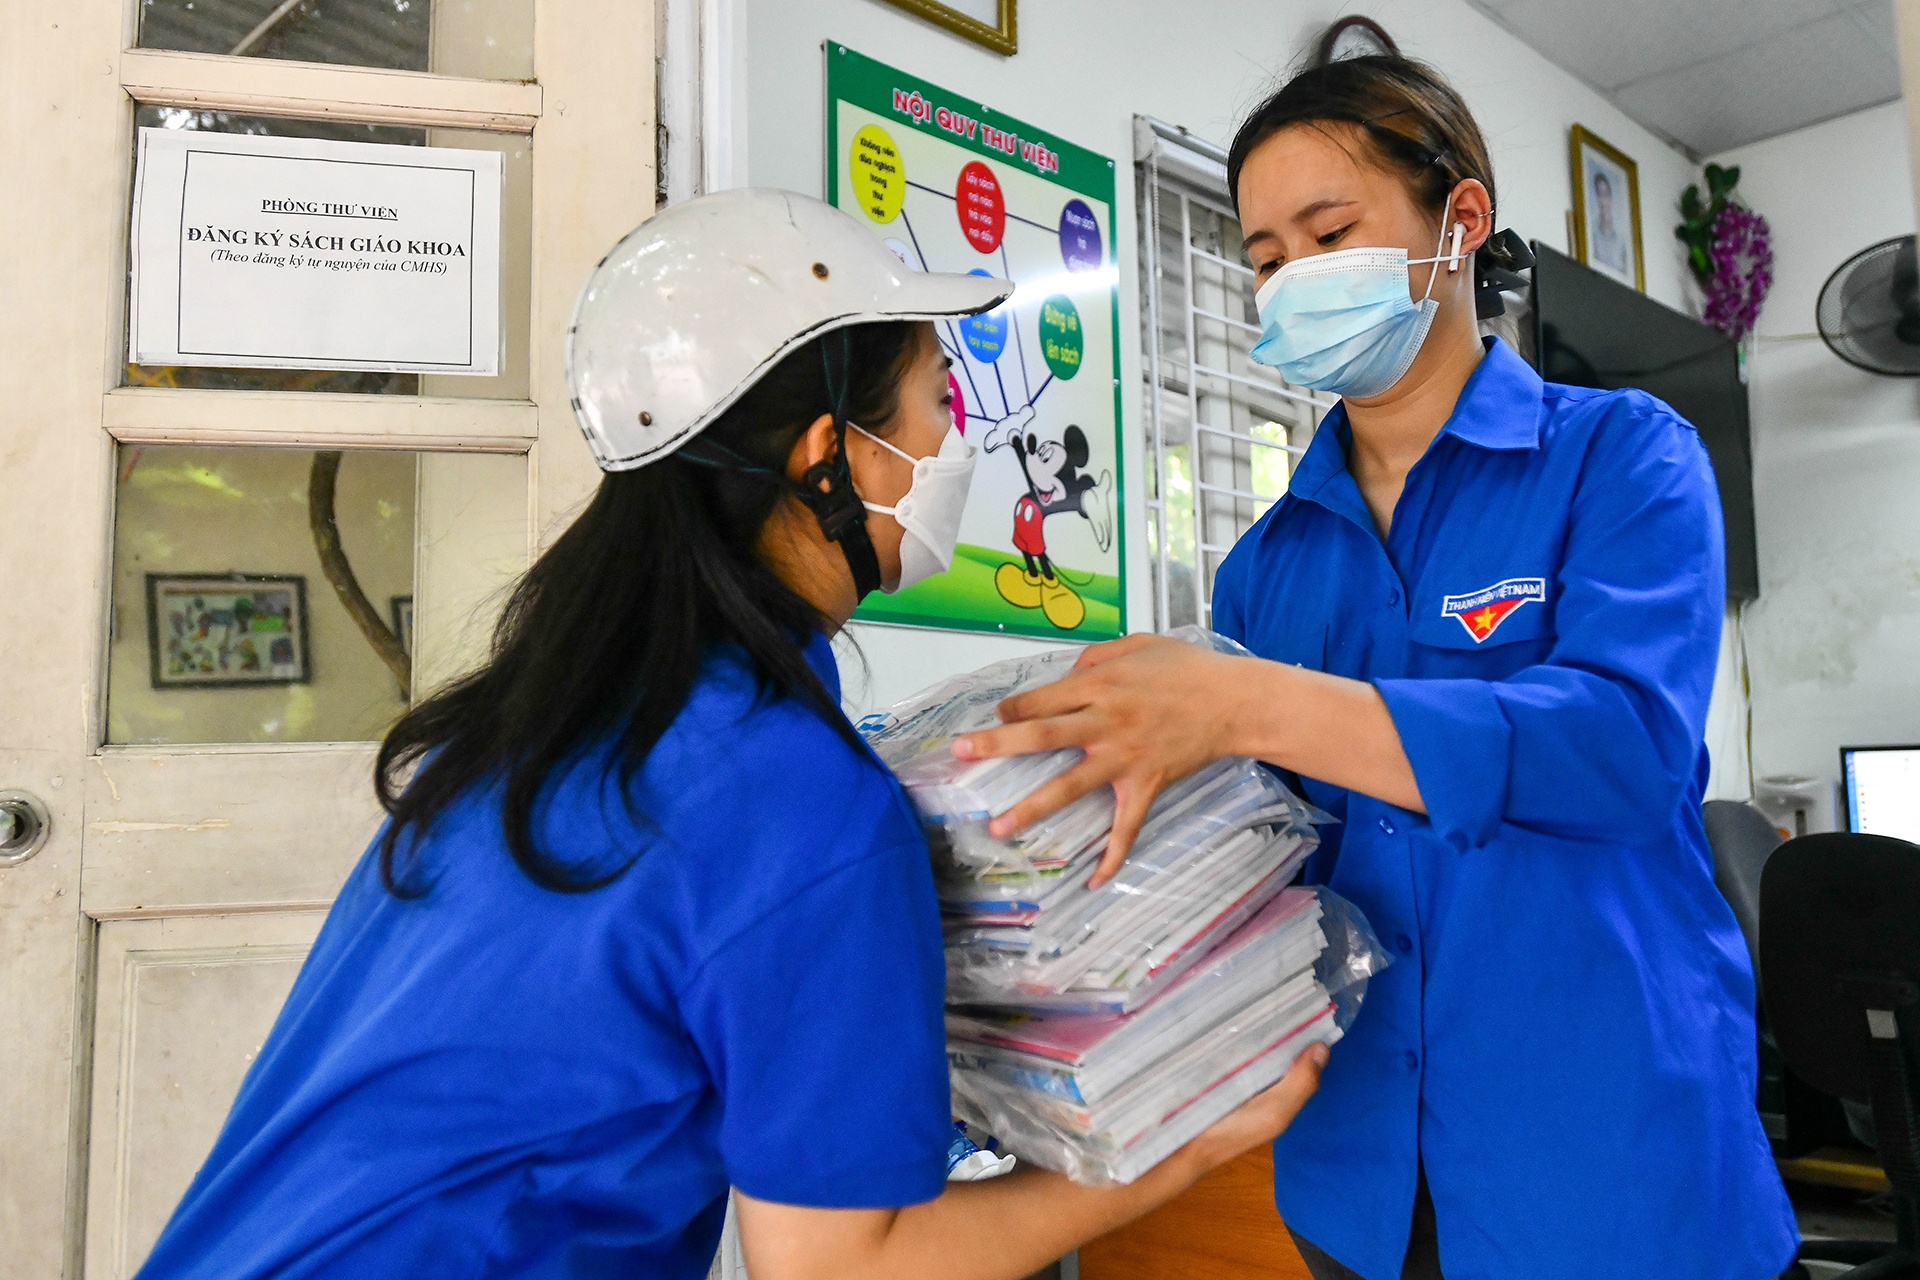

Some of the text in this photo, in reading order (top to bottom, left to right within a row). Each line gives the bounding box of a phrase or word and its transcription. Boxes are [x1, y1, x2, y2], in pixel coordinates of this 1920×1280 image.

[892, 87, 1059, 174] NỘI QUY THƯ VIỆN
[262, 198, 398, 219] PHÒNG THƯ VIỆN
[187, 225, 466, 256] ĐĂNG KÝ SÁCH GIÁO KHOA
[210, 249, 447, 276] (Theo đăng ký tự nguyện của CMHS)
[1045, 303, 1066, 333] Đừng
[1060, 342, 1079, 365] sách
[1513, 584, 1540, 595] NAM
